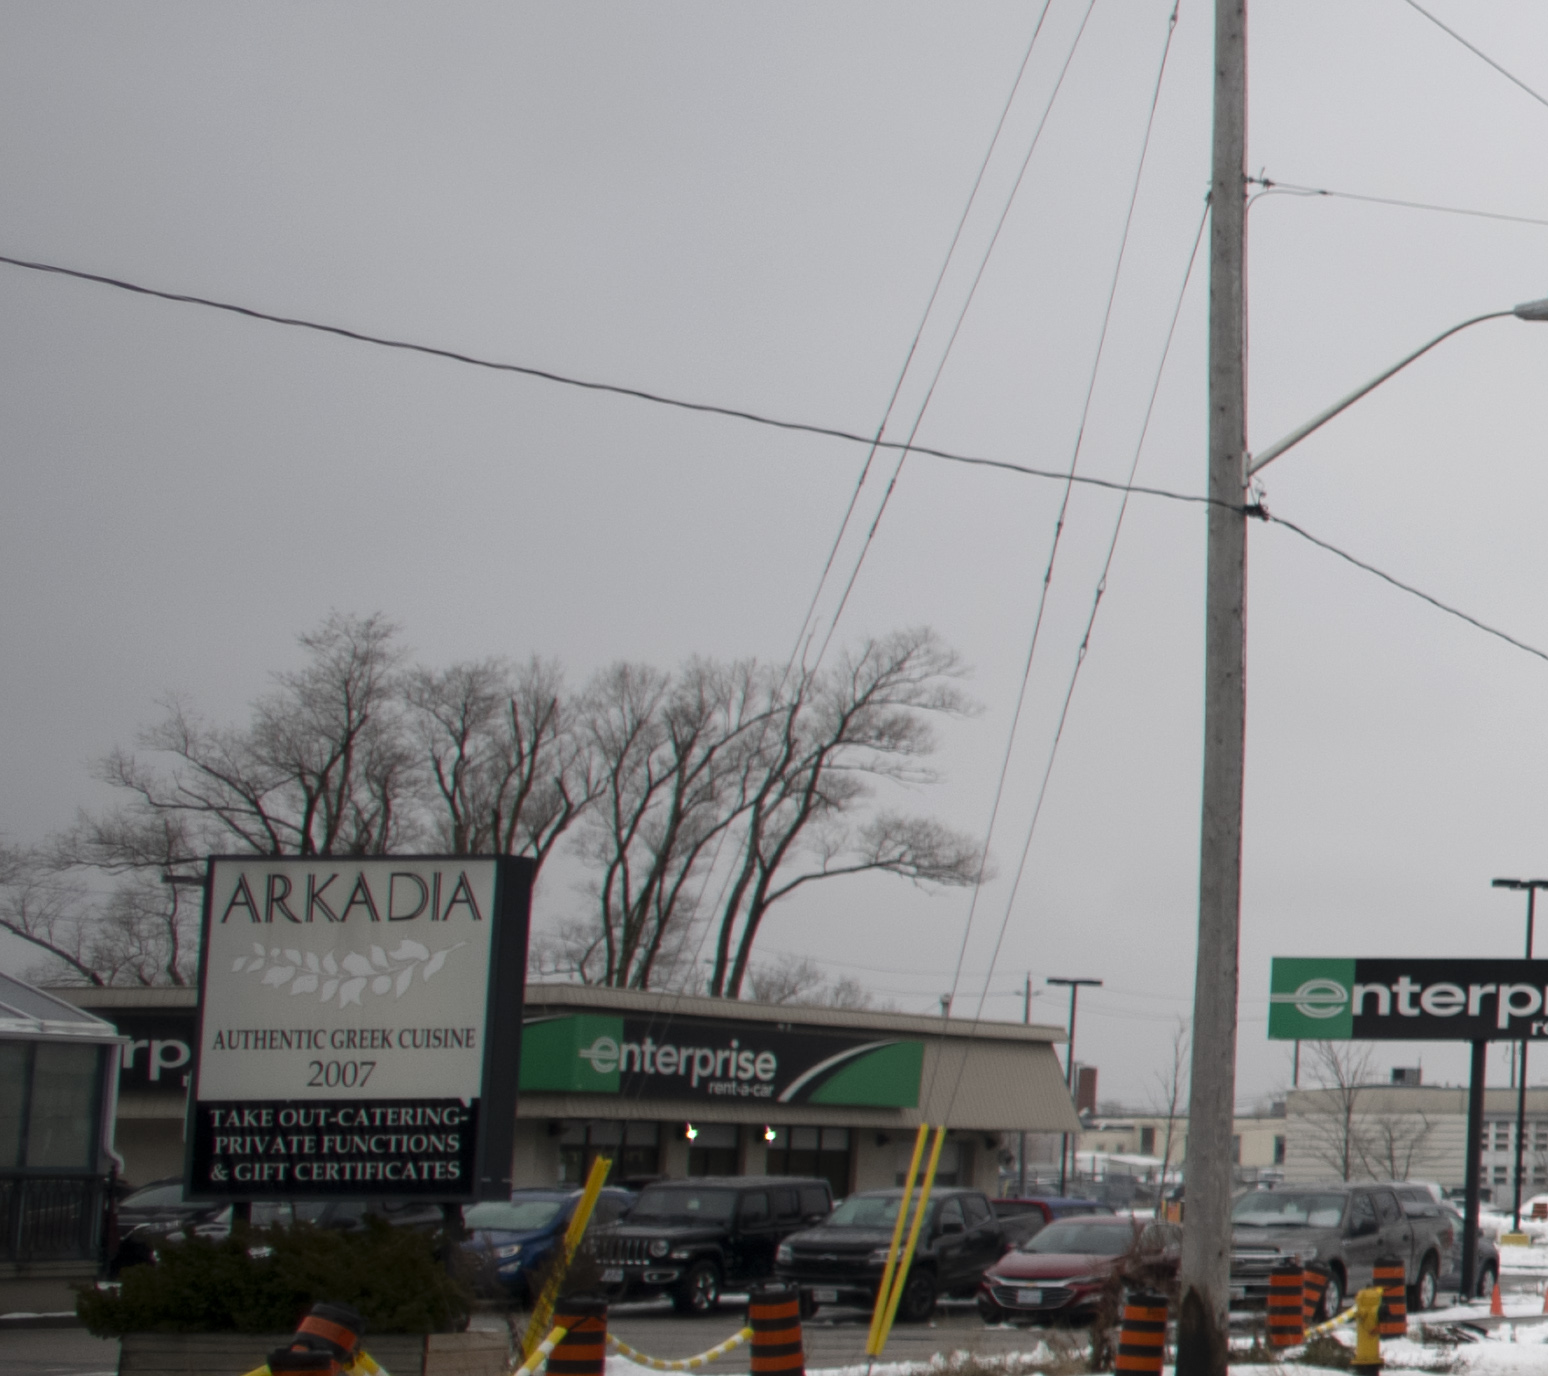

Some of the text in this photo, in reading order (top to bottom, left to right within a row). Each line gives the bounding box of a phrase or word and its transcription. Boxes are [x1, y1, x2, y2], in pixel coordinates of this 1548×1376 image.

[221, 871, 482, 923] ARKADIA
[213, 1028, 476, 1050] AUTHENTIC GREEK CUISINE
[579, 1035, 778, 1088] enterprise
[306, 1060, 377, 1088] 2007
[708, 1080, 775, 1098] rent-a-car
[210, 1106, 468, 1127] TAKE OUT-CATERING-
[214, 1134, 461, 1155] PRIVATE FUNCTIONS
[210, 1161, 461, 1182] & GIFT CERTIFICATES
